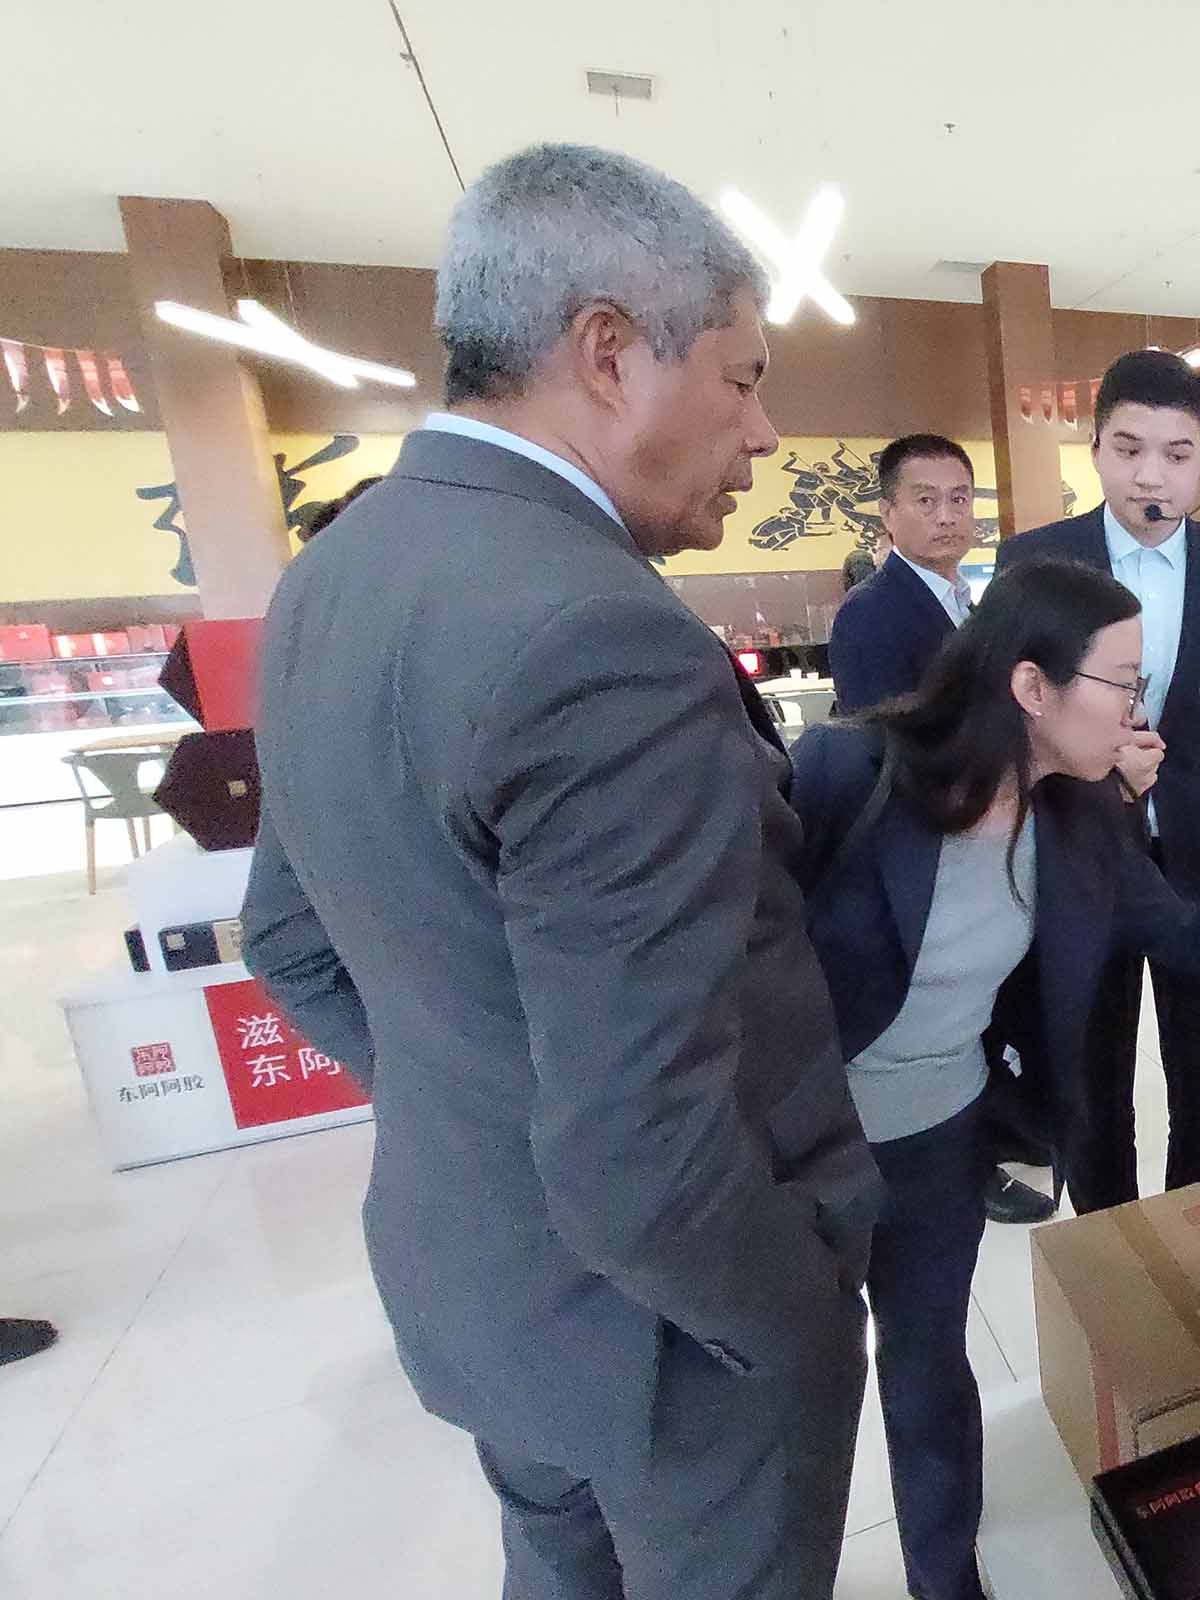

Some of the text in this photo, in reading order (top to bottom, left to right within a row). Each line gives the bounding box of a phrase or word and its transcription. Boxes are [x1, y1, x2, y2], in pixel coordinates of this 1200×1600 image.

[237, 1012, 296, 1049] 滋
[118, 1074, 205, 1103] 东阿阿胶
